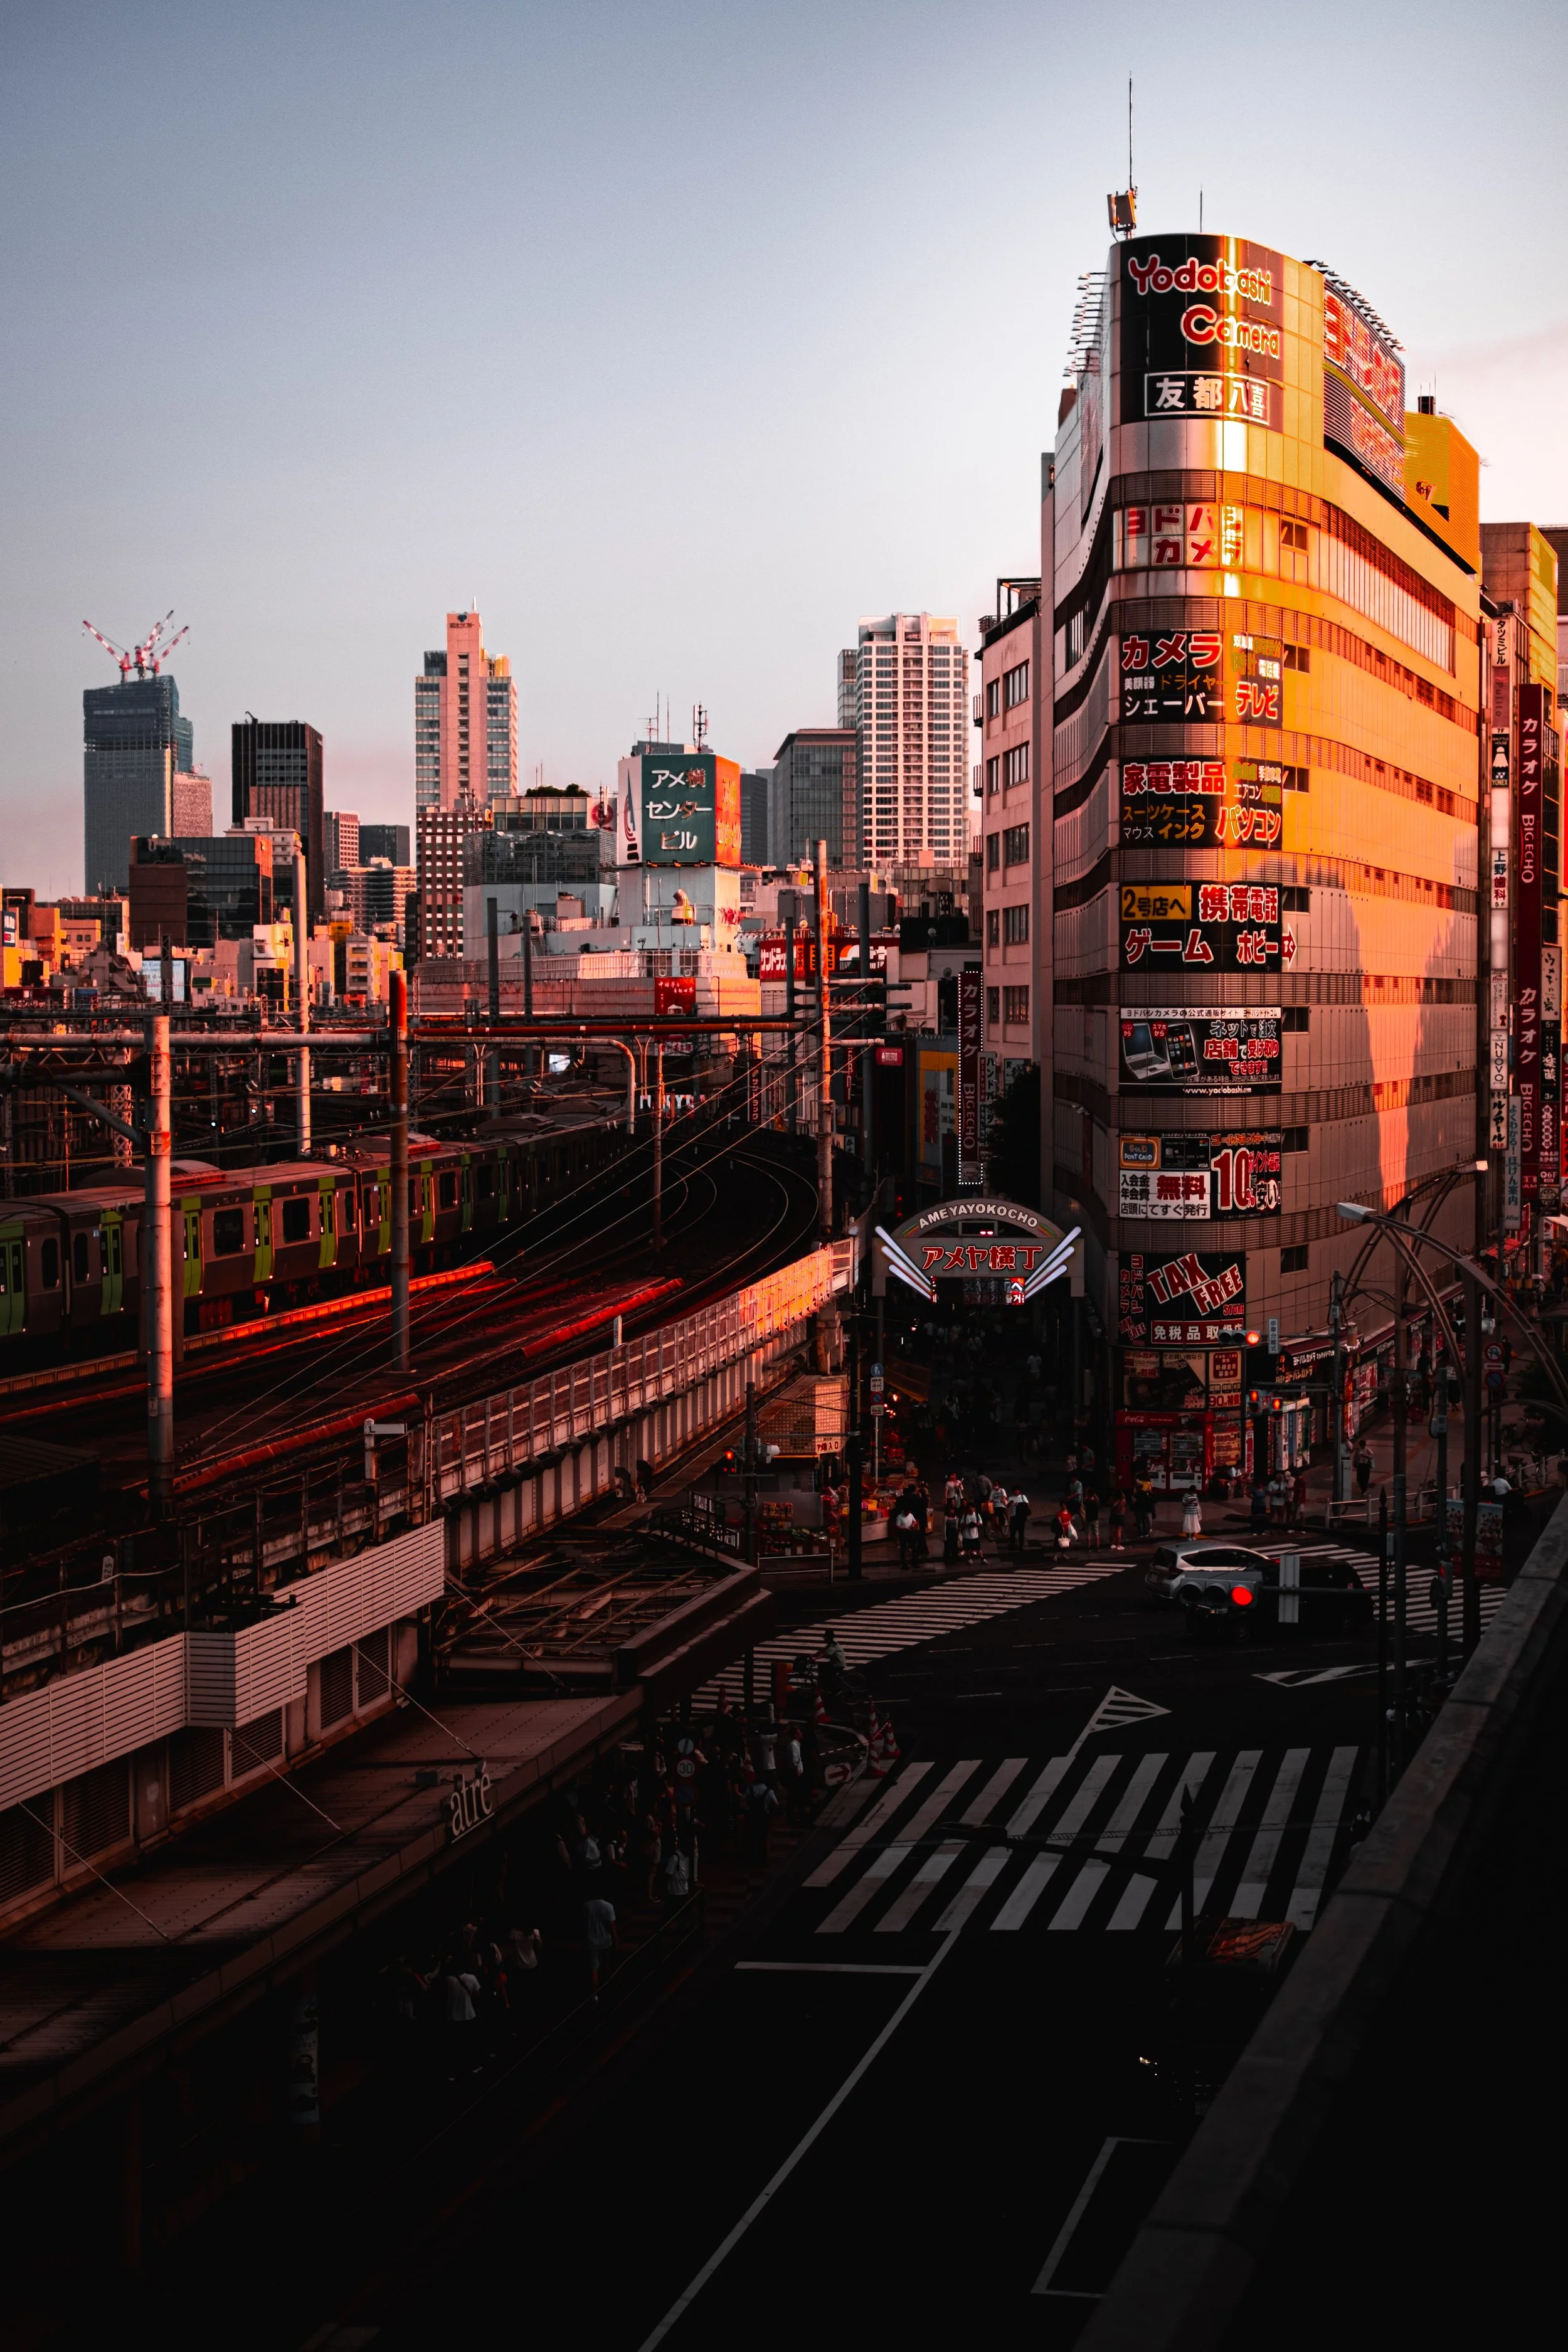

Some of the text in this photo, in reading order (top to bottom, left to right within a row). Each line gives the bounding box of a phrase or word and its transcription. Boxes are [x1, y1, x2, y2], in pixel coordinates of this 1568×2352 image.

[1155, 376, 1264, 418] 友都八喜
[1121, 633, 1223, 670] カメラ
[1496, 620, 1506, 665] タツミビル
[1232, 652, 1258, 676] 時計
[1161, 674, 1229, 691] ドライヤー
[1125, 692, 1224, 716] シェーバー
[1235, 681, 1279, 719] テレビ
[1520, 718, 1538, 795] カラオケ
[651, 768, 706, 788] アメ横
[1123, 760, 1226, 796] 家電製品
[1233, 783, 1262, 800] エアコン
[645, 800, 712, 819] センター
[1123, 805, 1205, 821] スーツケース
[1214, 804, 1281, 843] パソコン
[660, 830, 698, 850] ビル
[1123, 822, 1205, 839] マウス インク
[1521, 815, 1535, 883] BIG ECHO
[1123, 889, 1186, 918] 2号店へ
[1199, 884, 1278, 924] 携帯電話
[1125, 928, 1214, 964] ゲーム
[1236, 930, 1278, 965] ホビー
[963, 983, 978, 1057] カラオケ
[1209, 1020, 1277, 1037] ネットで注文
[1519, 987, 1537, 1064] カラオケ
[1204, 1038, 1279, 1060] 店舗で受け取り
[1494, 1042, 1504, 1082] NUOVO
[963, 1083, 975, 1149] BIG ECHO
[1492, 1101, 1505, 1142] ルノアール
[1520, 1083, 1534, 1152] BIG ECHO
[1121, 1174, 1150, 1187] 入会金
[1121, 1187, 1150, 1201] 年会費
[1157, 1175, 1206, 1200] 無料
[918, 1203, 1038, 1229] AMEYAYOKOCHO
[1120, 1202, 1208, 1216] 店頭にてすぐ発行
[922, 1245, 1043, 1271] アメヤ横丁
[1120, 1269, 1130, 1314] カメラ
[1131, 1254, 1144, 1314] ヨドバシ
[1147, 1253, 1210, 1305] TAX
[1190, 1262, 1244, 1316] FREE
[1223, 1303, 1245, 1316] STORE
[1119, 1315, 1135, 1335] TAX
[1128, 1322, 1147, 1340] FREE
[1188, 1385, 1204, 1395] VISA
[679, 1763, 693, 1774] 30
[450, 1761, 492, 1836] atré
